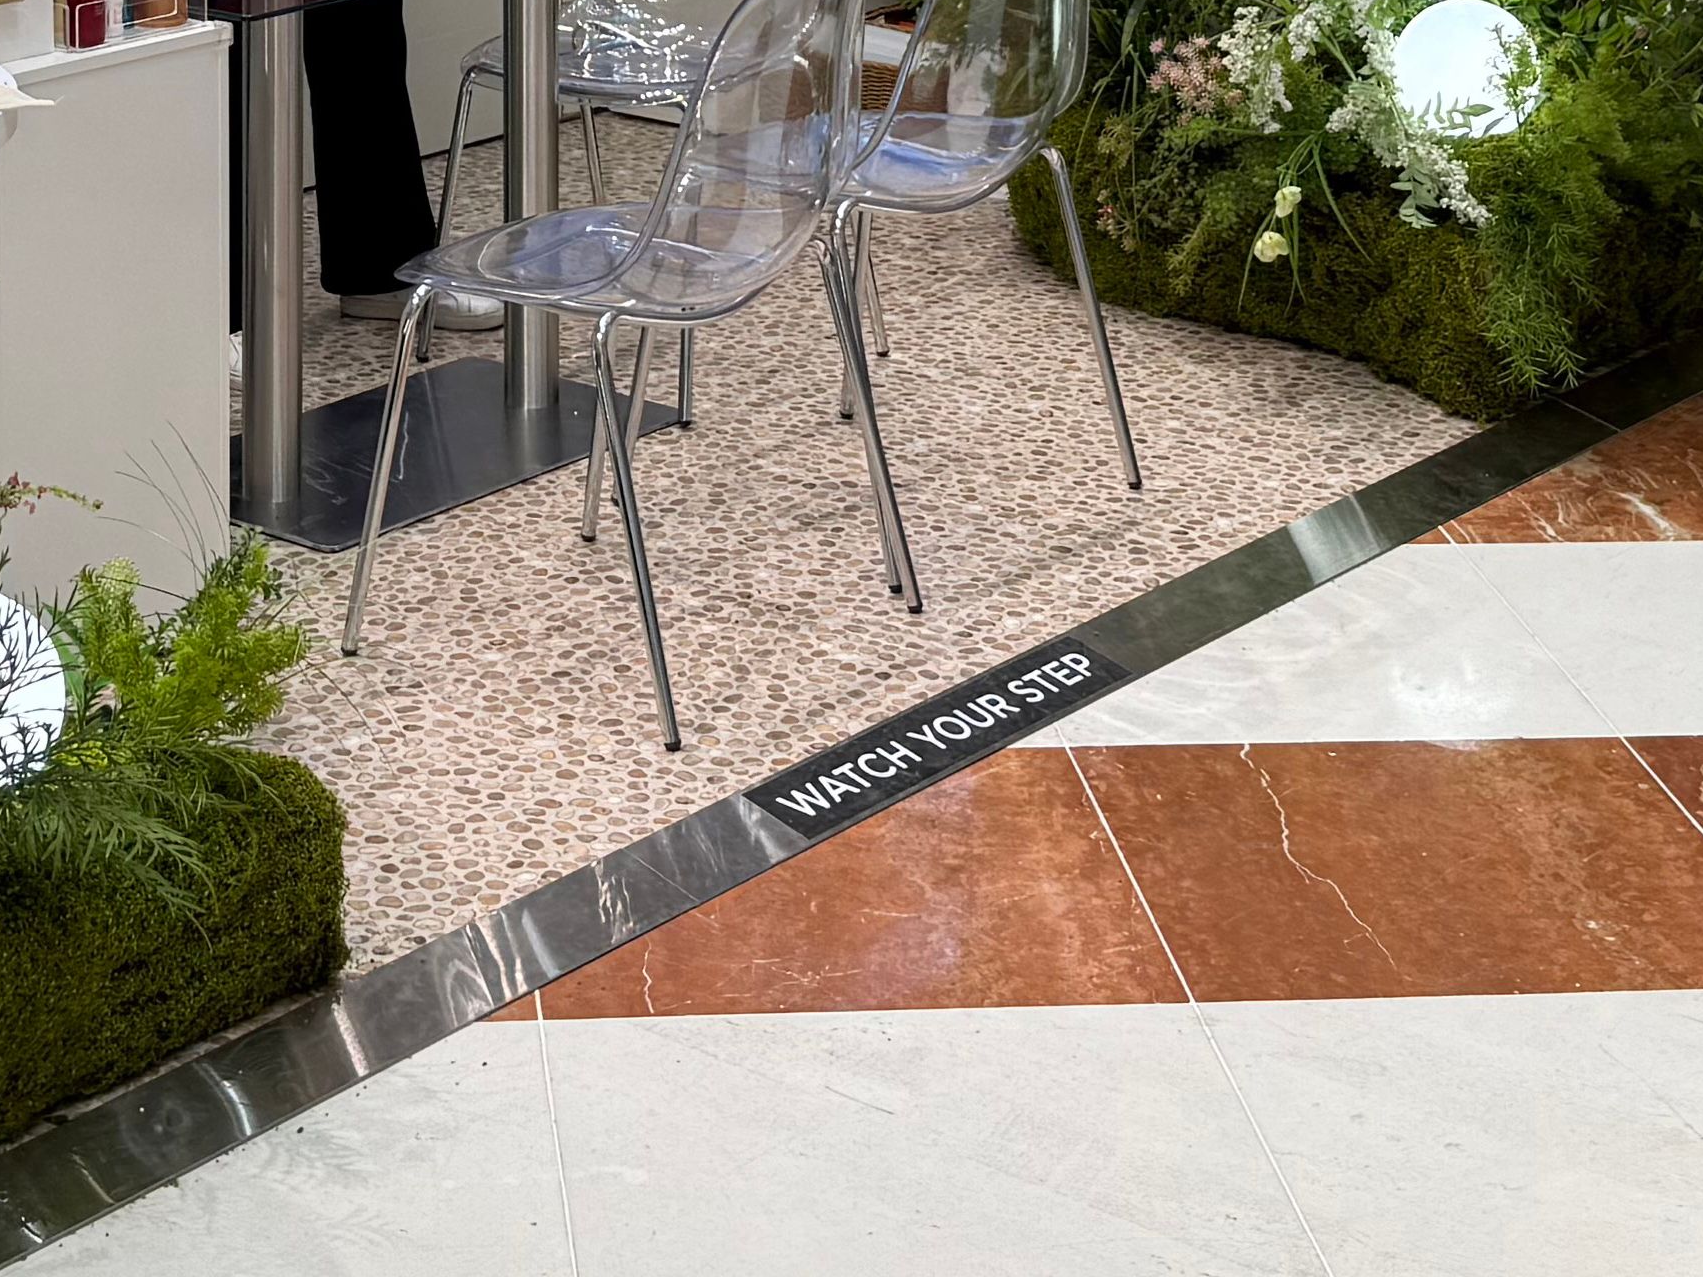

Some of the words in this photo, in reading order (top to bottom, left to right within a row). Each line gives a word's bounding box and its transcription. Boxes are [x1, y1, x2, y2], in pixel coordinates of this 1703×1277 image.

[775, 739, 924, 818] WATCH
[906, 694, 1021, 752] YOUR
[1006, 651, 1093, 705] STEP
